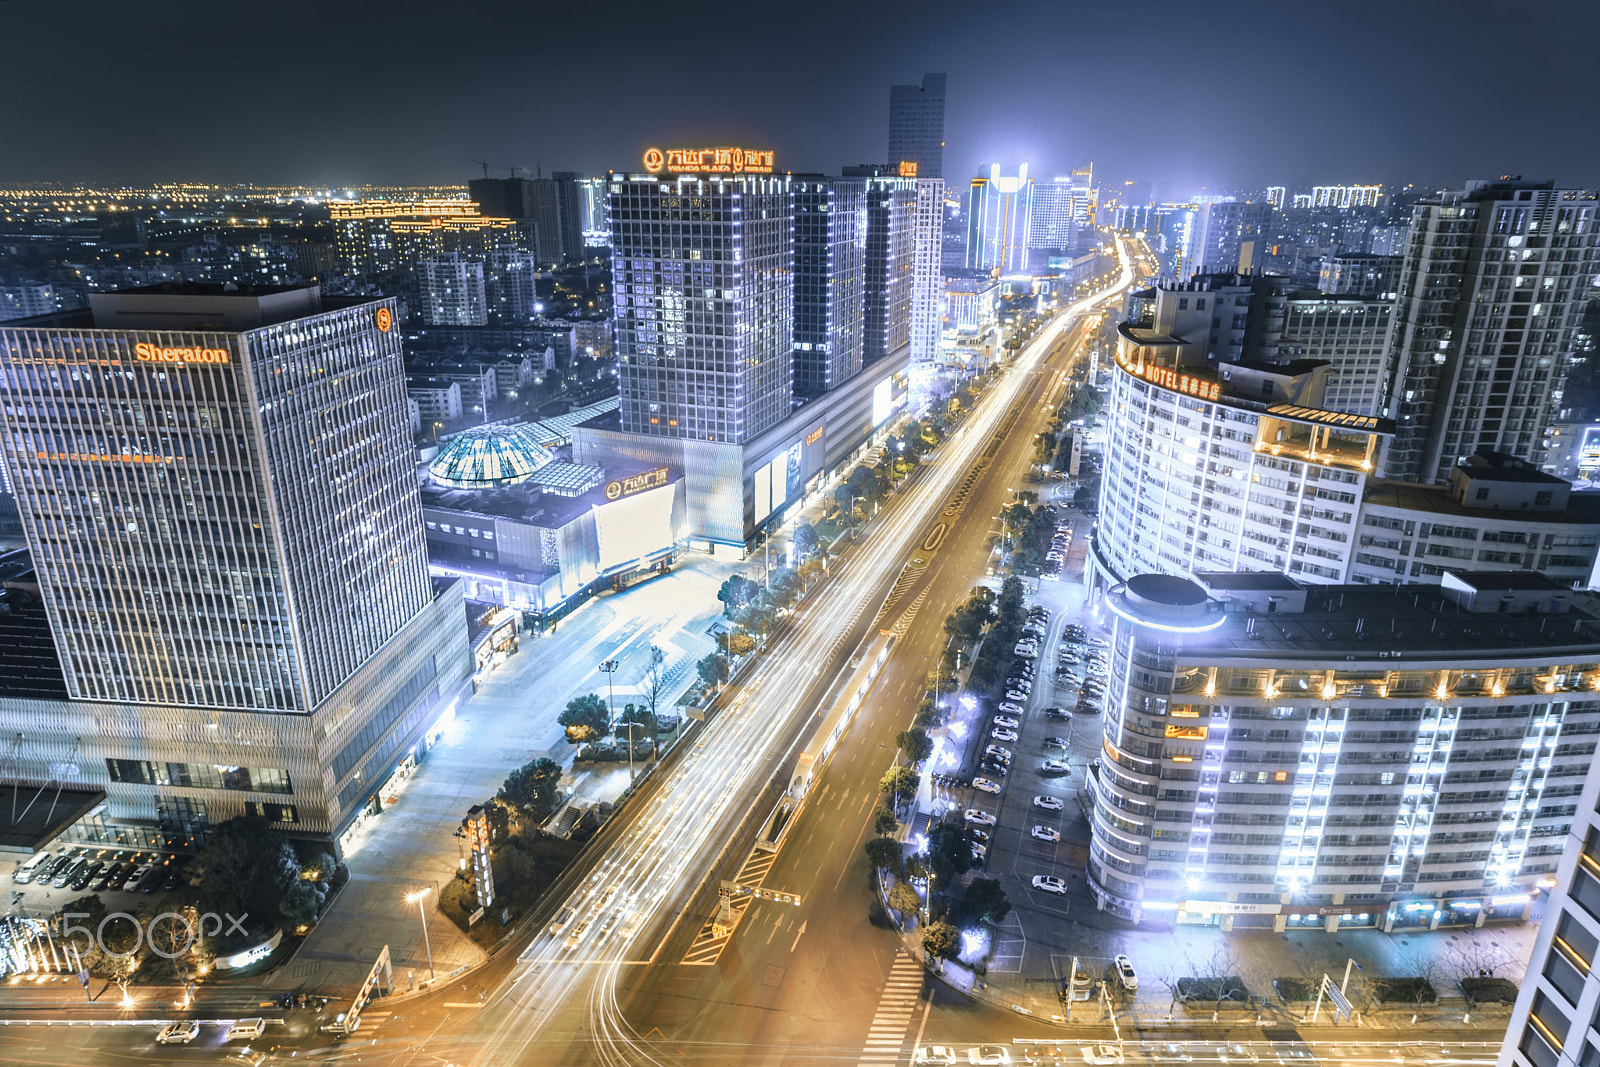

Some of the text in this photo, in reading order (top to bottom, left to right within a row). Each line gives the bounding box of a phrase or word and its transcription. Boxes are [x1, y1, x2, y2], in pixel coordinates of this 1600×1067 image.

[666, 149, 731, 165] 万达广场
[135, 342, 229, 364] Sheraton
[1145, 364, 1178, 390] MOTEL
[1179, 375, 1220, 401] 莫泰酒店
[622, 469, 667, 491] 万达广场
